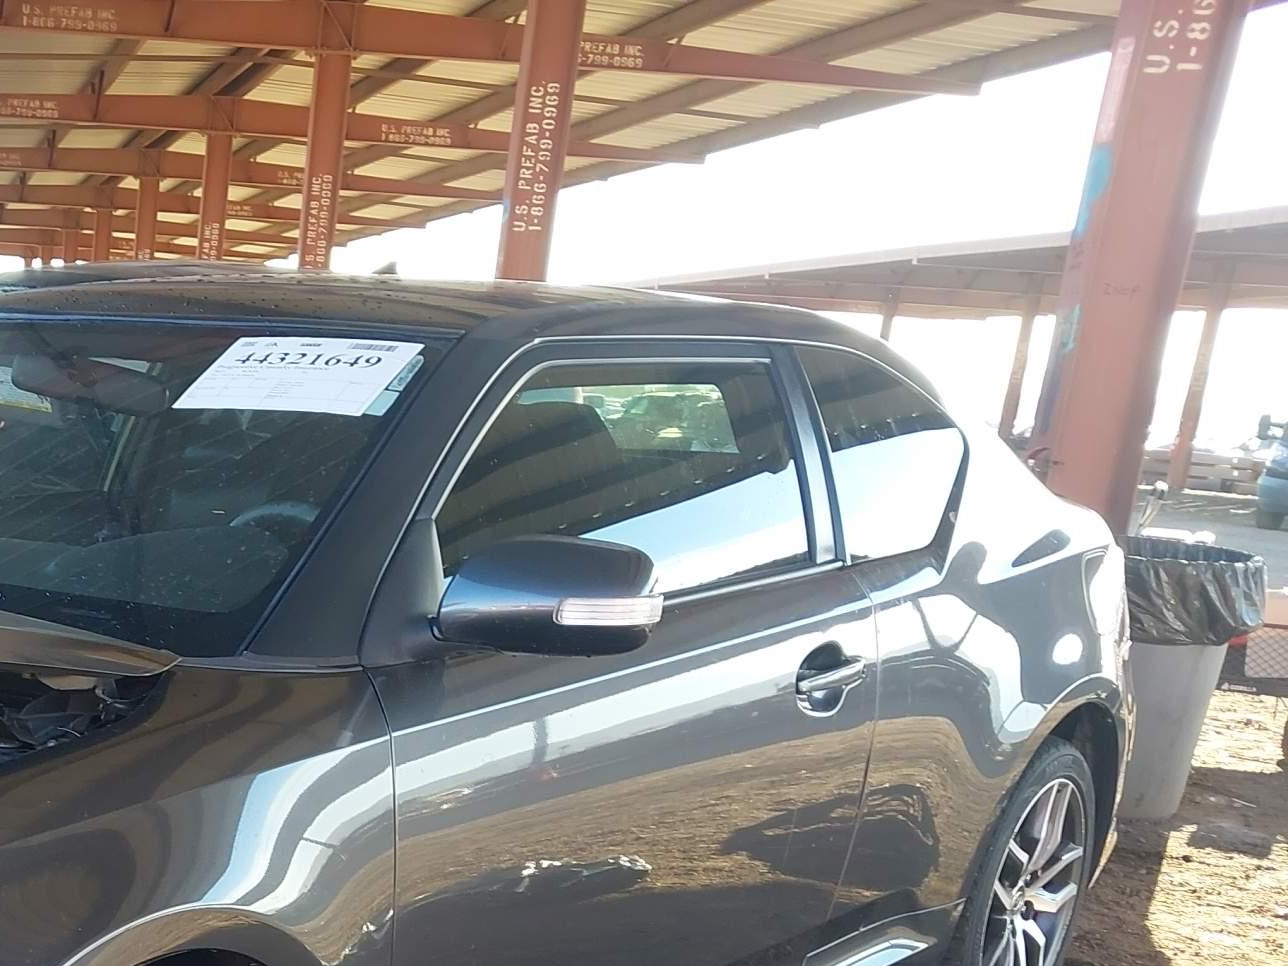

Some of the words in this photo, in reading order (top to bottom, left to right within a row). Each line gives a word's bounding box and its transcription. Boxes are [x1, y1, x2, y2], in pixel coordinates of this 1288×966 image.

[1143, 9, 1184, 74] U.S.
[528, 81, 547, 113] INC.
[518, 123, 540, 190] PREFAB
[528, 83, 561, 231] 1-866-799-0969
[306, 201, 320, 245] PREFAB
[513, 199, 531, 232] U.S.
[234, 352, 383, 368] 44321649
